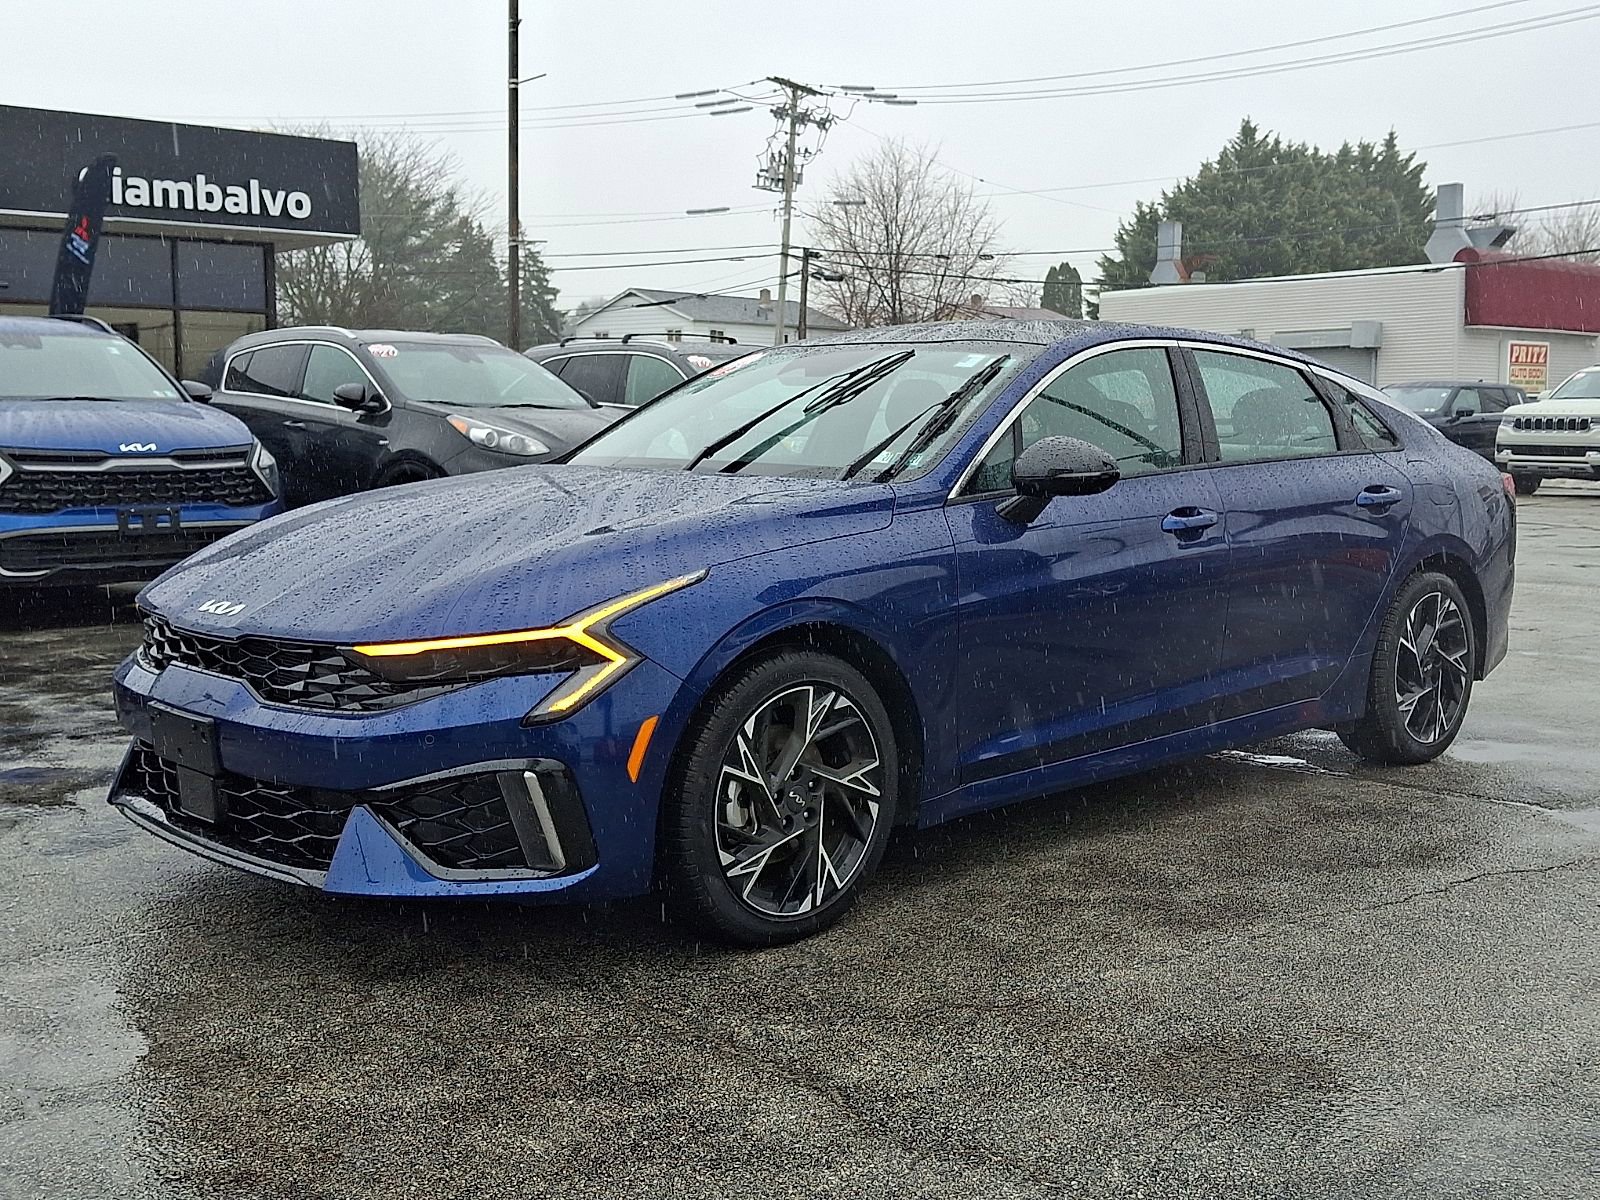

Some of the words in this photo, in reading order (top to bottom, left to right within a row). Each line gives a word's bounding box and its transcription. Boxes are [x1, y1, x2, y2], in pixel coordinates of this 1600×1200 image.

[79, 166, 312, 219] iambalvo
[1511, 345, 1547, 363] PRITZ
[1511, 367, 1527, 378] AUTO
[1528, 368, 1545, 379] BODY
[119, 443, 157, 452] KIA
[198, 599, 246, 616] KIA
